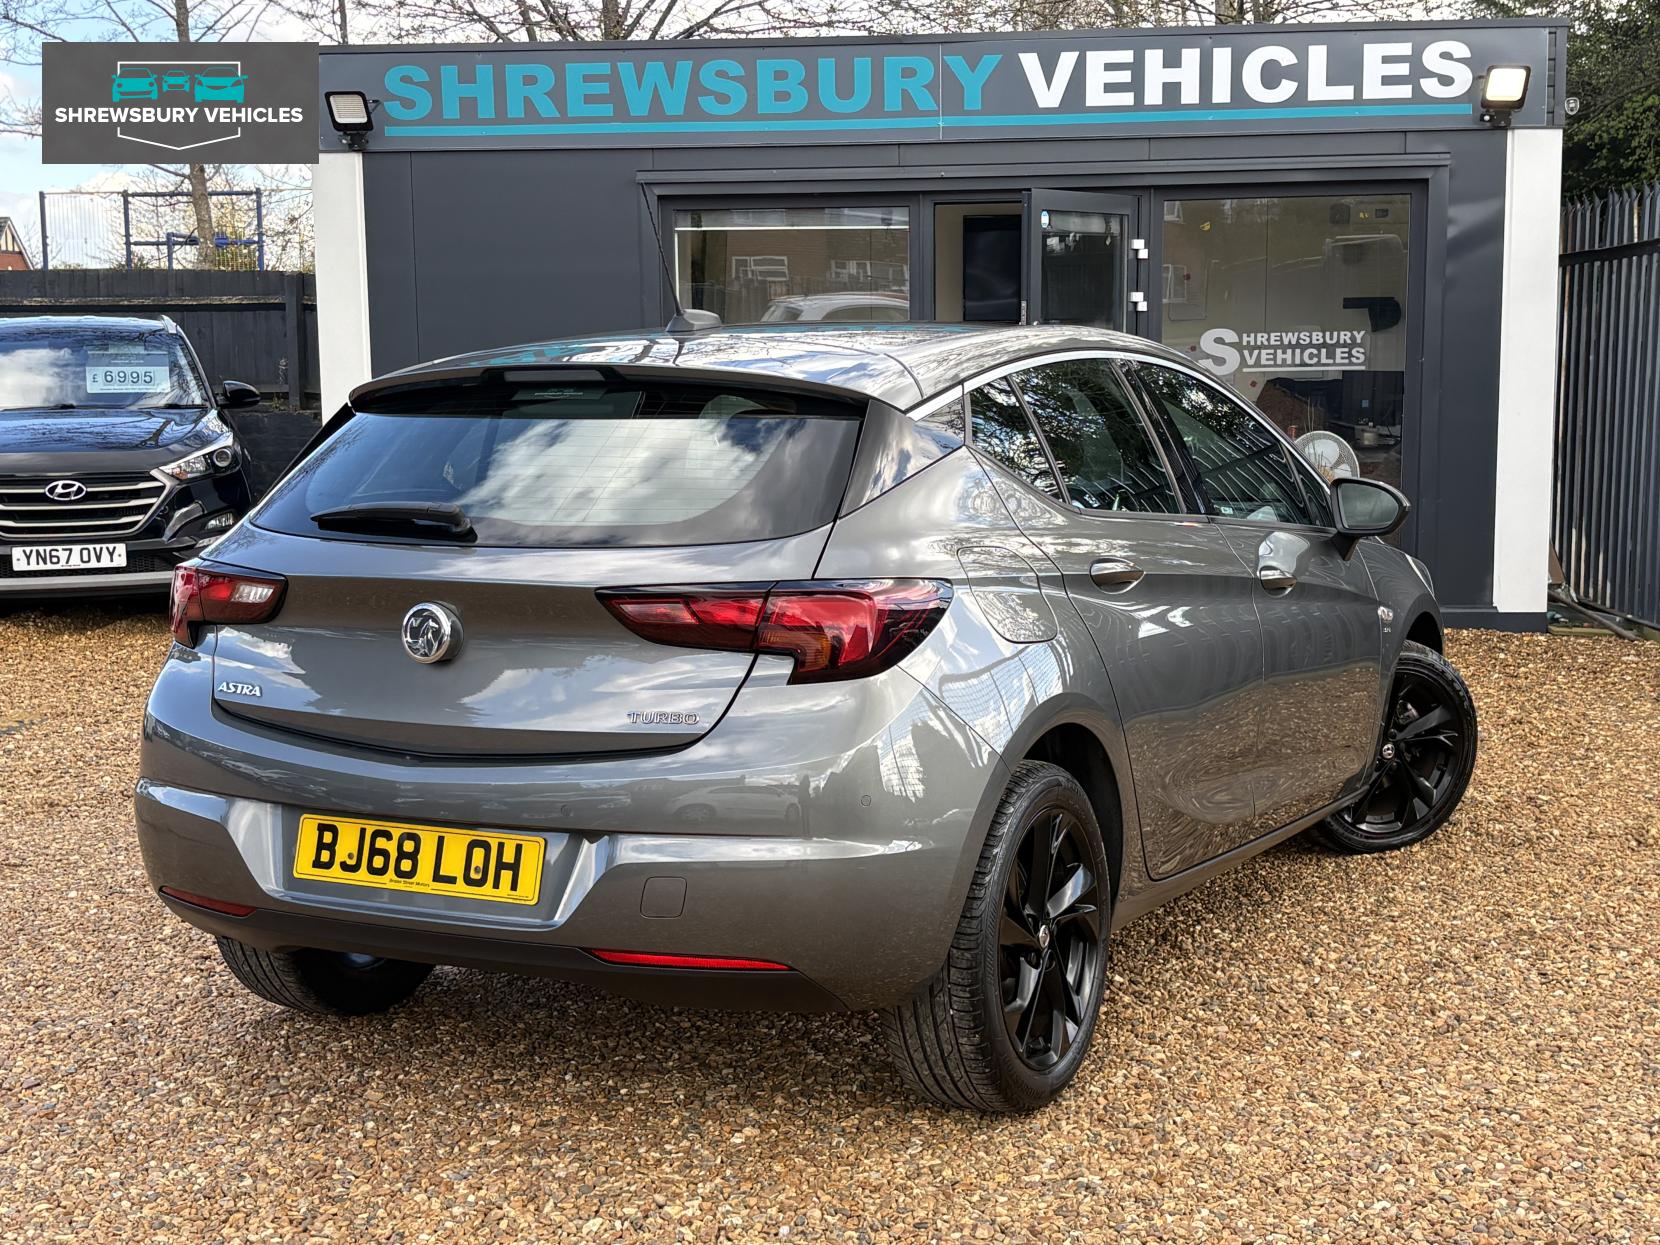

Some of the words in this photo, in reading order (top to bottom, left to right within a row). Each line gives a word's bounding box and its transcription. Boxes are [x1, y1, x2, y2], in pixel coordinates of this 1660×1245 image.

[384, 54, 1003, 120] SHREWSBURY
[1018, 40, 1474, 108] VEHICLES
[1198, 328, 1366, 376] SHREWSBURY
[1243, 347, 1366, 366] VEHICLES
[104, 370, 153, 384] 6995
[22, 547, 73, 566] YN67
[80, 546, 116, 563] OVY
[217, 681, 262, 697] ASTRA
[627, 711, 700, 725] TURBO
[312, 822, 422, 879] BJ68
[432, 835, 524, 892] LOH
